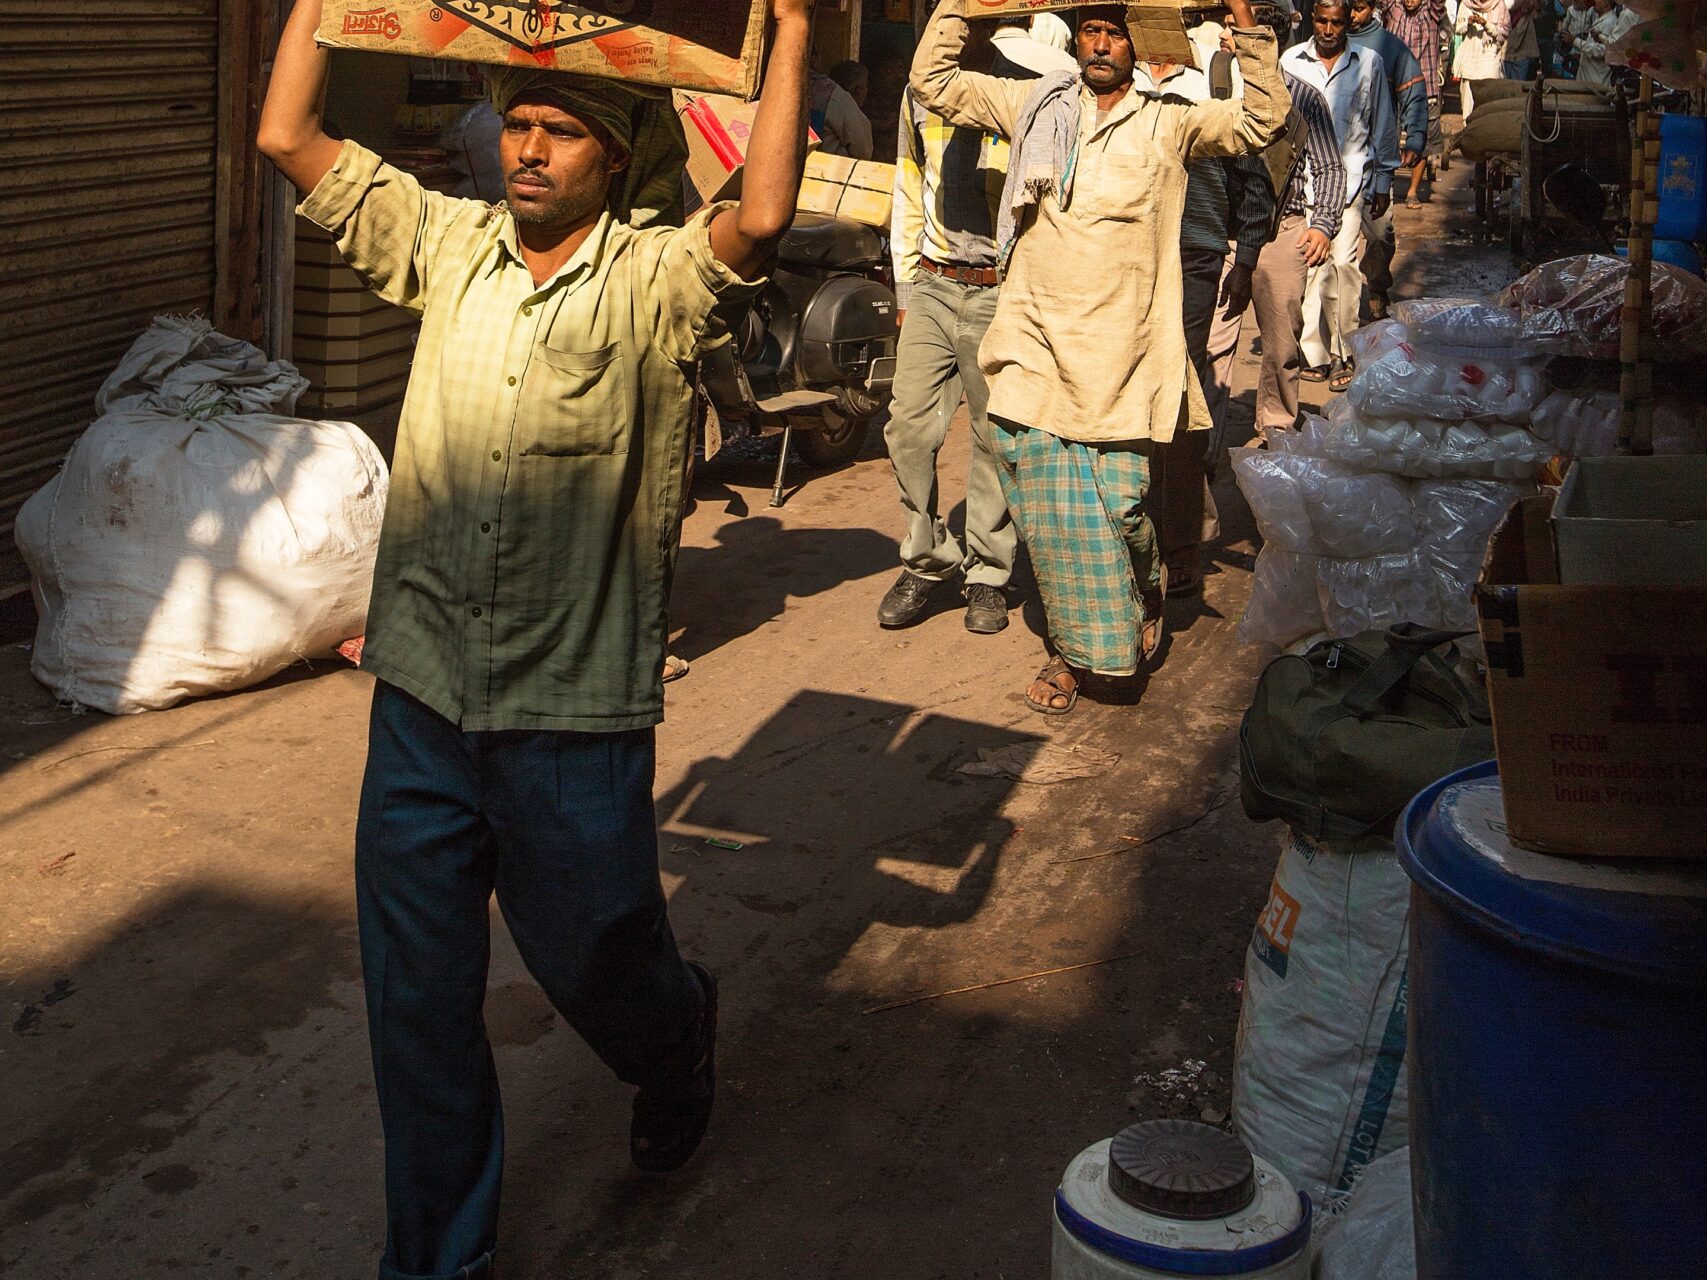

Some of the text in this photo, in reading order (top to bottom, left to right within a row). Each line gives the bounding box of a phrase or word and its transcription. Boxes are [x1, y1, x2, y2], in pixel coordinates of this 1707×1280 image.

[341, 8, 401, 39] अजन्ता
[1550, 732, 1609, 753] FROM
[1554, 784, 1601, 804] India
[1353, 1119, 1378, 1158] LOT
